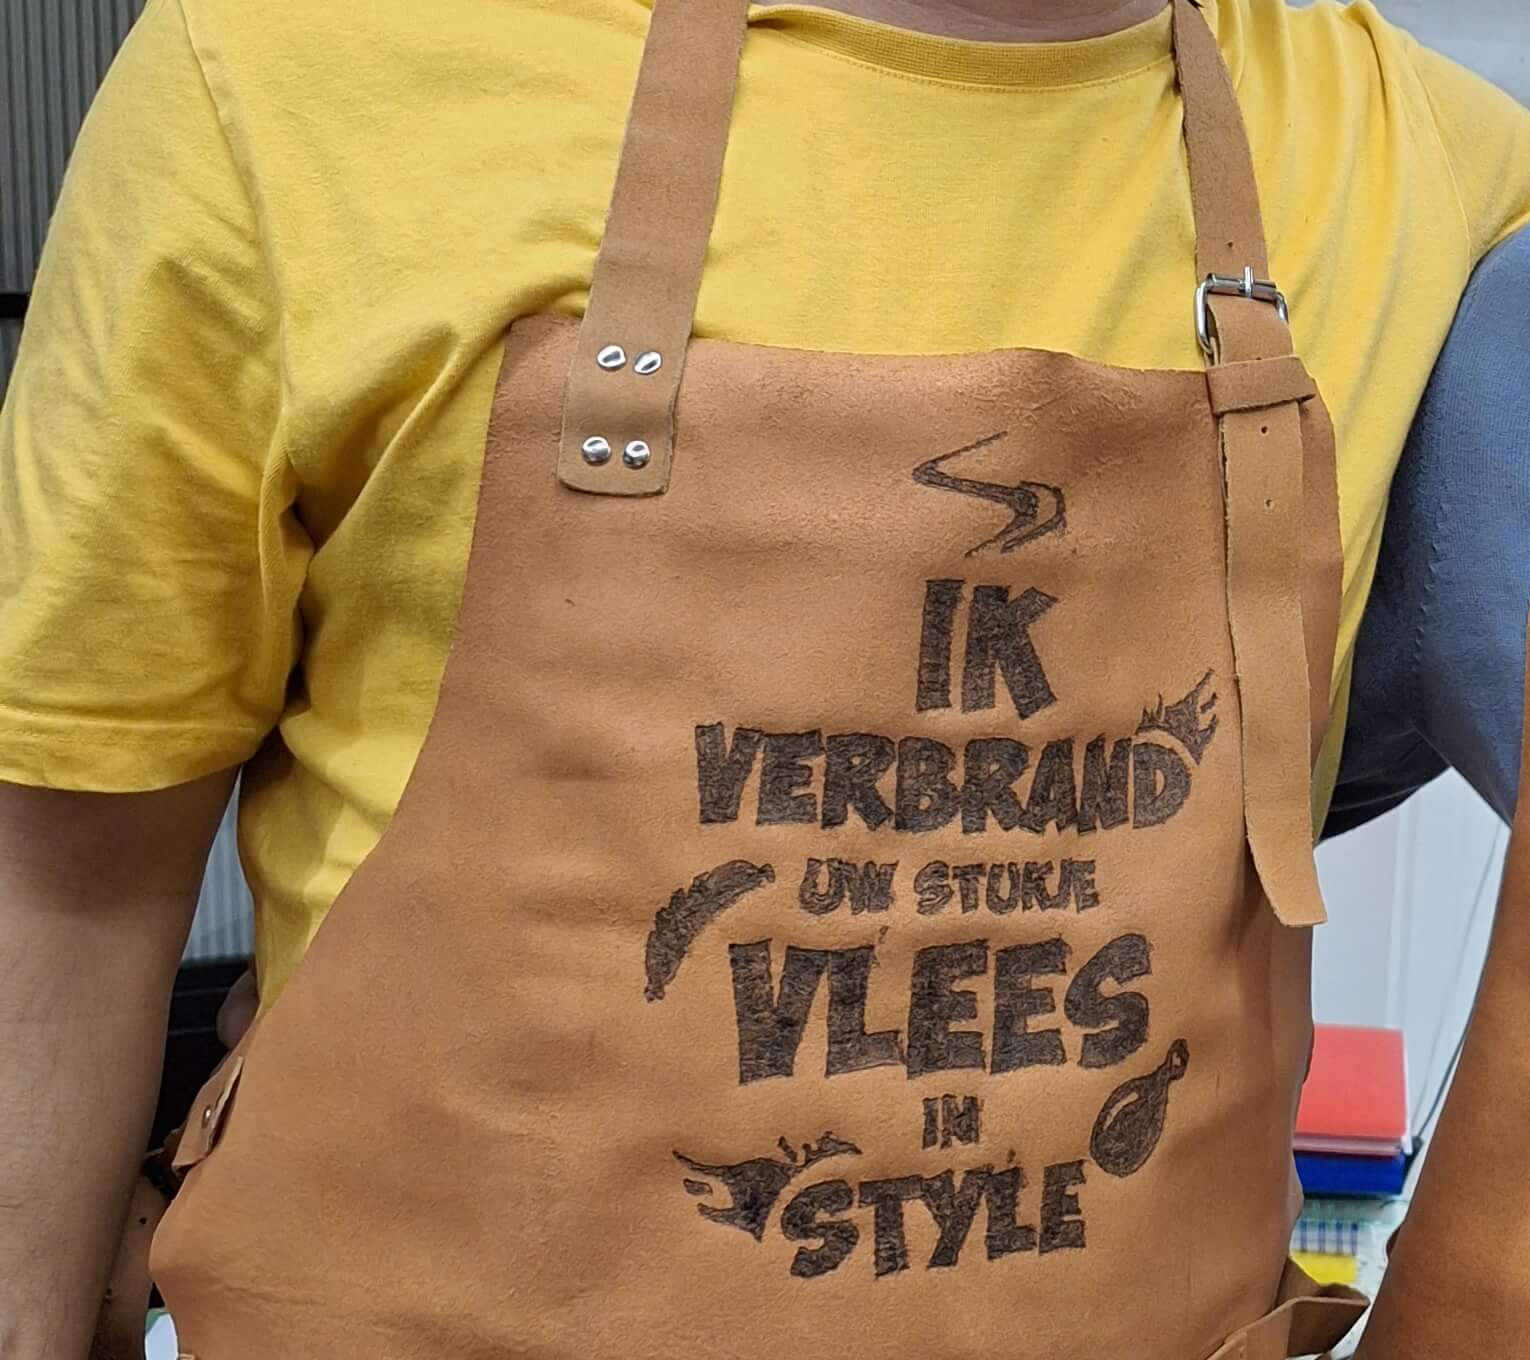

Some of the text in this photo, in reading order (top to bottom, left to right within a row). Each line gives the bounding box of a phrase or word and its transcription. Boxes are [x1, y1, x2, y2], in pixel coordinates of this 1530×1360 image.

[914, 579, 1057, 719] IK
[694, 722, 1194, 836] VERBRAND
[799, 857, 1099, 917] UW STUKJE
[729, 933, 1155, 1086] VLEES
[921, 1094, 984, 1150] IN
[780, 1158, 1087, 1279] STYLE
